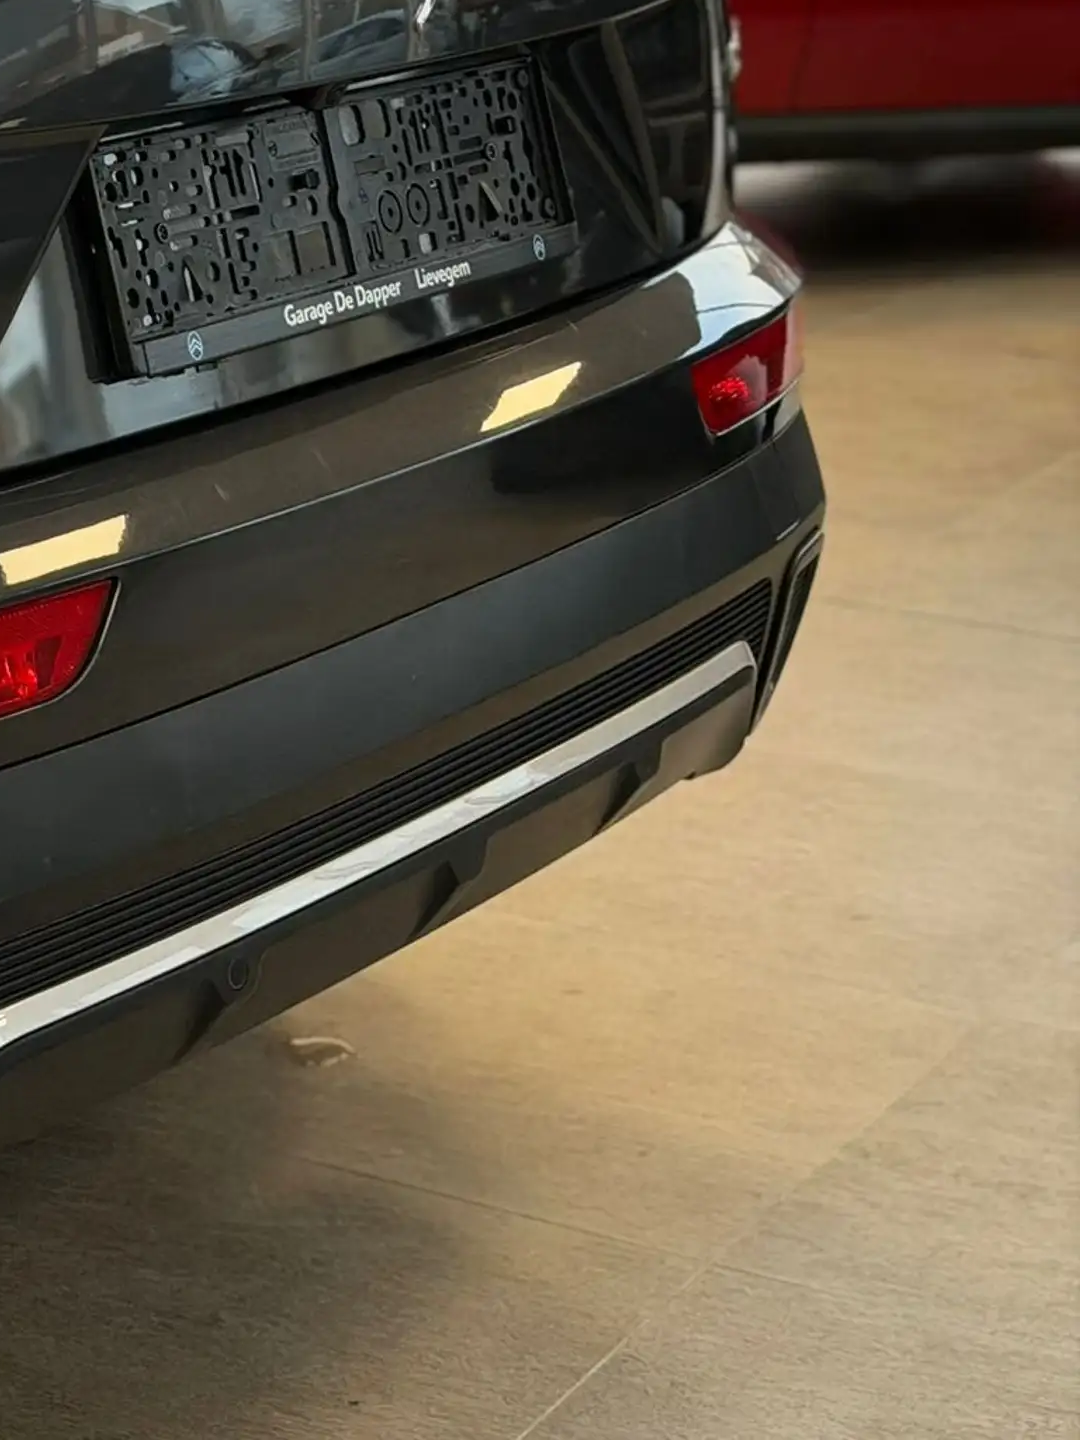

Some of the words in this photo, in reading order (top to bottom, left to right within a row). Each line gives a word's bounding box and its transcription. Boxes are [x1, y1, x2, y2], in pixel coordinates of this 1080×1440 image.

[283, 304, 334, 327] Garage
[333, 290, 354, 313] De
[354, 281, 402, 309] Dapper
[414, 261, 472, 290] Lievegem
